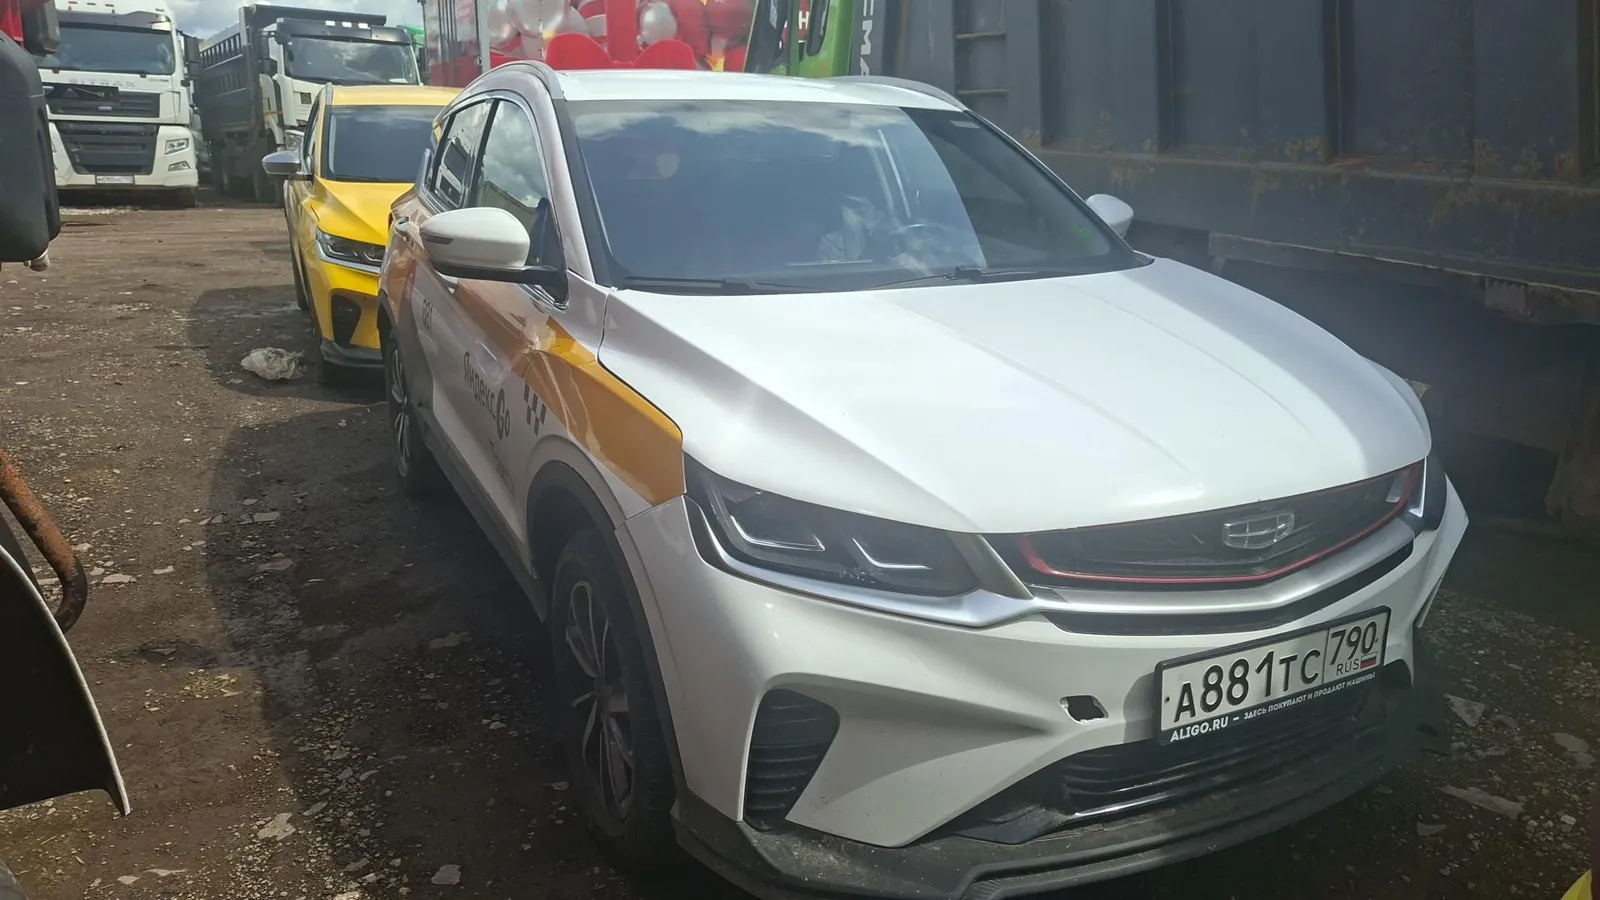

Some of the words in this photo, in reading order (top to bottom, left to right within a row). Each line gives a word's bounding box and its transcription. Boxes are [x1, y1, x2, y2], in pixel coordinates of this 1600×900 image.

[496, 388, 511, 441] Go
[1329, 621, 1377, 666] 790
[1336, 661, 1360, 676] RUS
[1170, 716, 1229, 742] ALIGO.RU
[1243, 707, 1267, 720] ЗДЕСЬ
[1267, 694, 1307, 711] ПОКУПАЮТ
[1314, 682, 1346, 698] ПРОДАЮТ
[1346, 671, 1376, 689] МАШИНЫ
